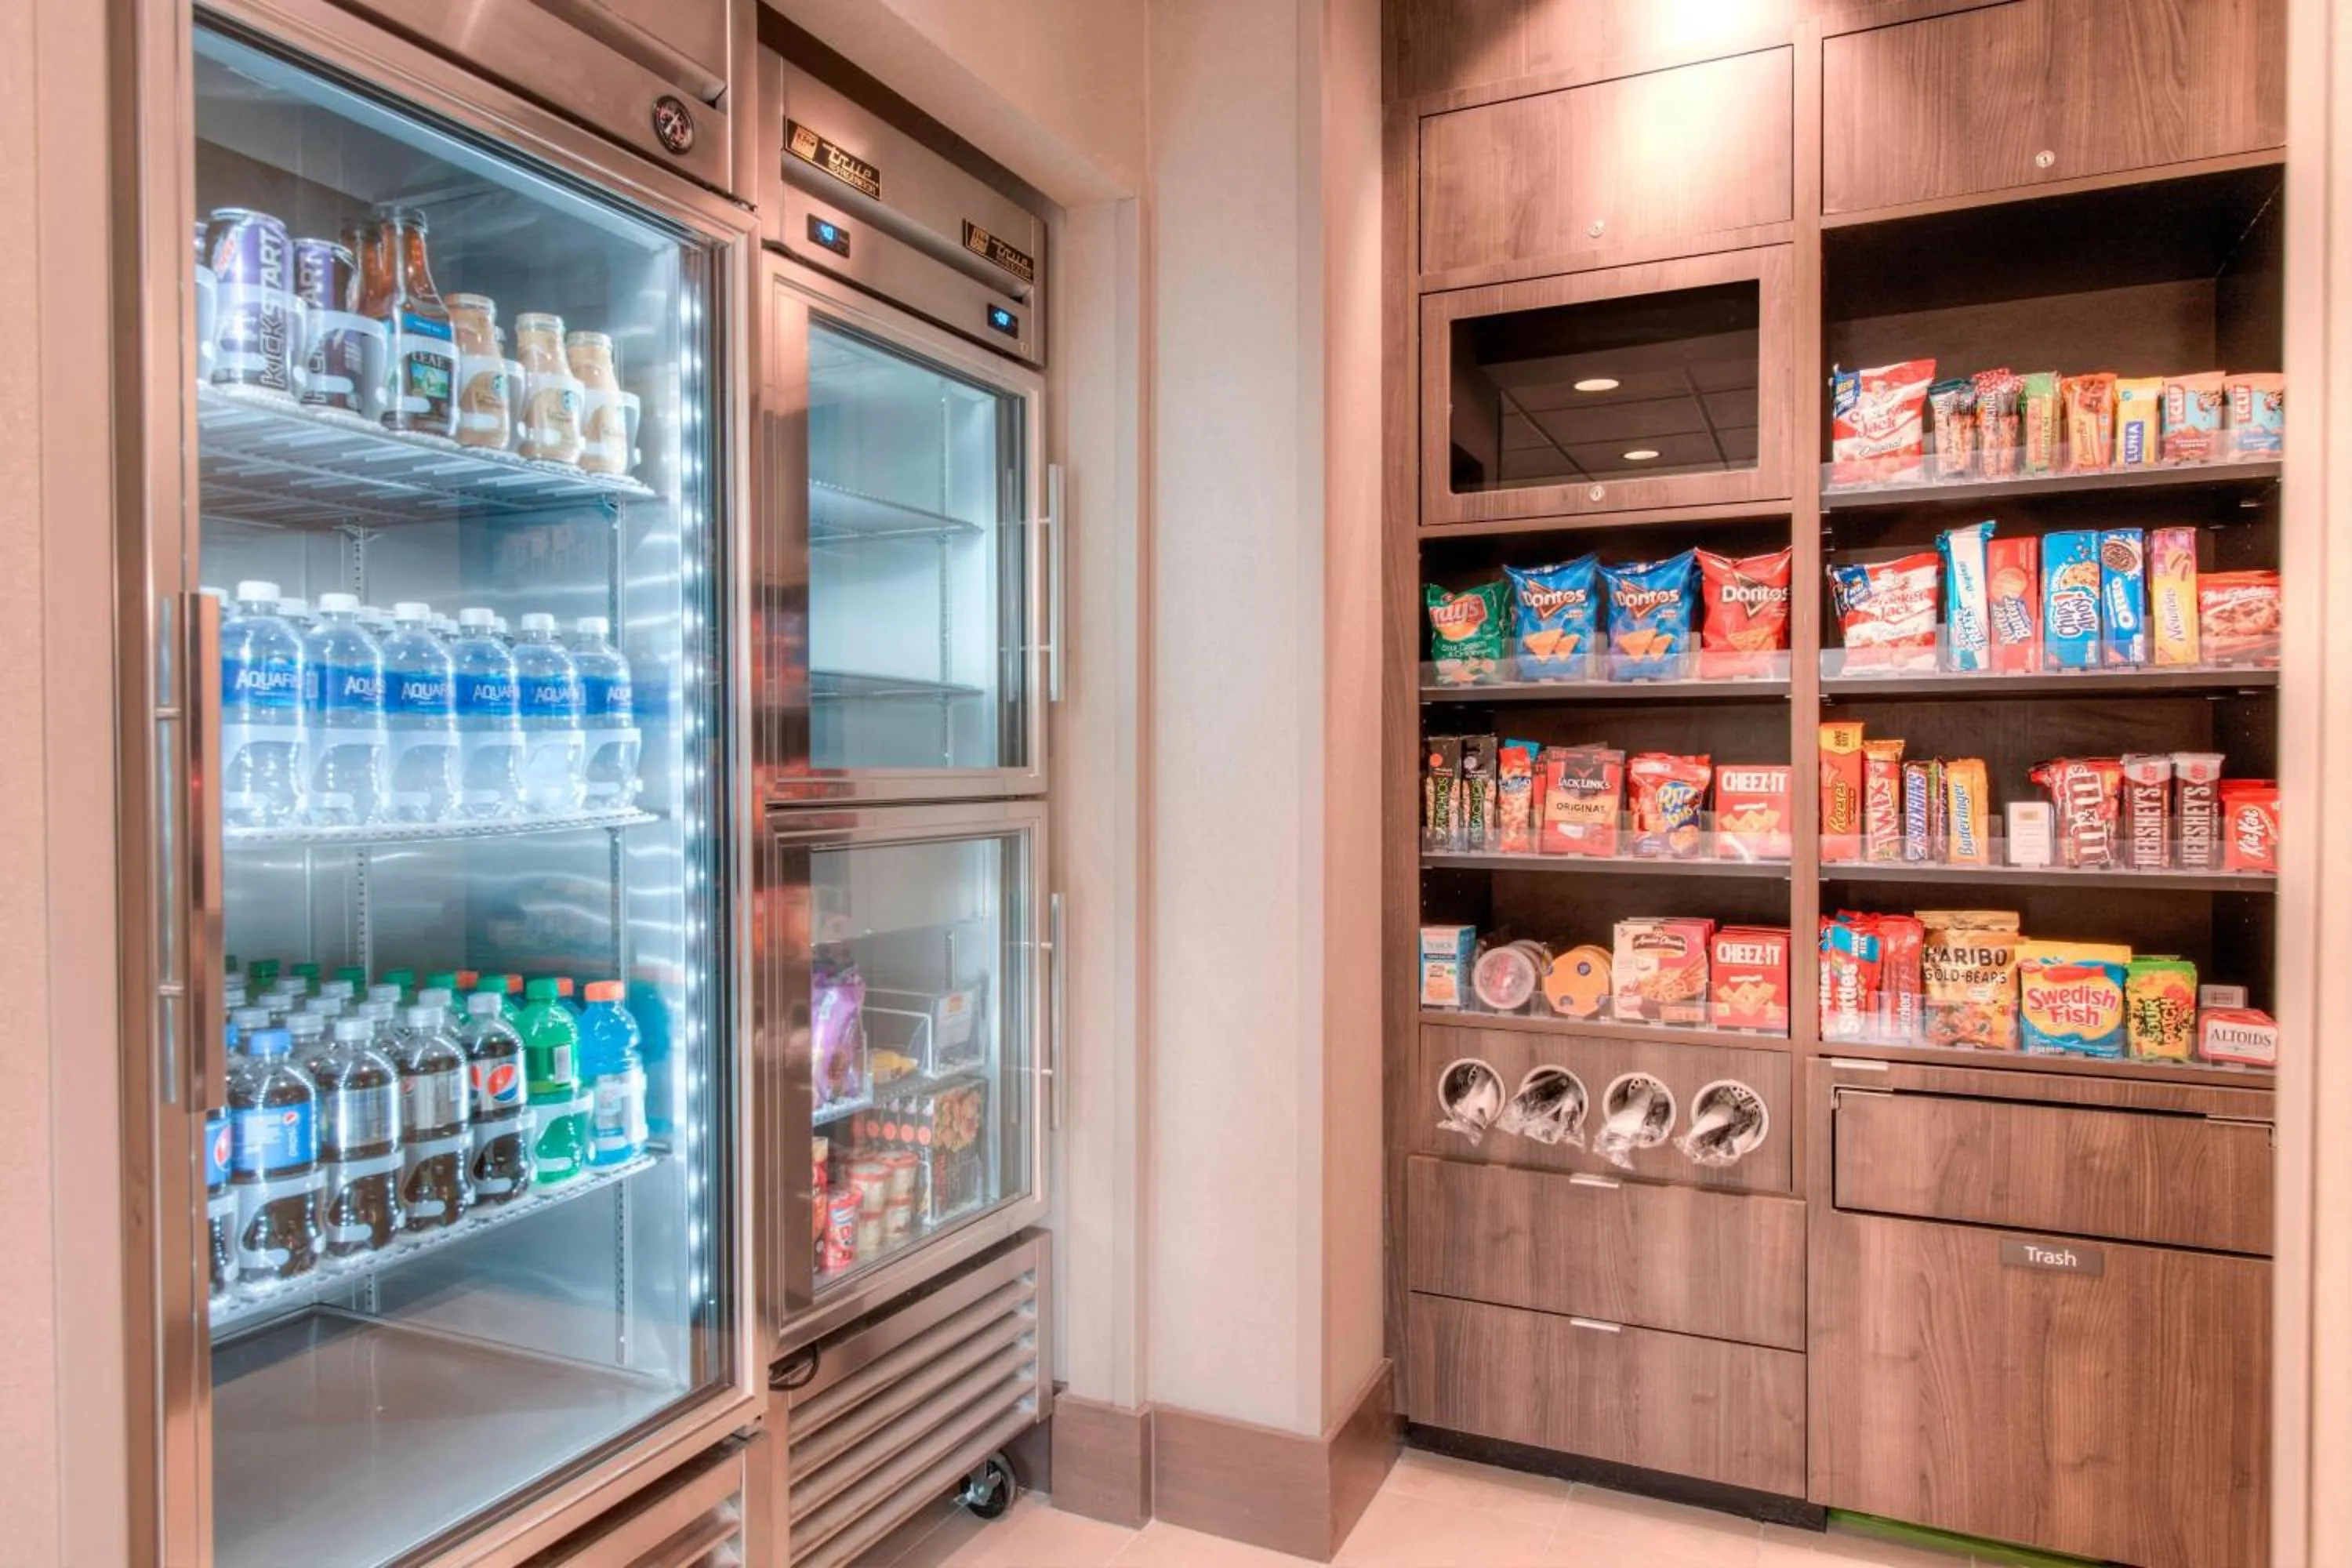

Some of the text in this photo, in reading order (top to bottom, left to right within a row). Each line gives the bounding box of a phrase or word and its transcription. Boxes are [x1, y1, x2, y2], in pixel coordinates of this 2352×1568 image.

[260, 227, 286, 390] KICKSTART
[2125, 423, 2141, 463] LUNA
[1522, 589, 1587, 607] Doritos
[1615, 589, 1680, 607] Doritos
[1722, 585, 1788, 603] Doritos
[2112, 577, 2135, 630] OREO
[1993, 603, 2018, 645] Nutter
[2004, 597, 2032, 641] Butter
[2057, 601, 2082, 637] Chips
[1865, 778, 1899, 854] TWIX
[1954, 782, 1975, 856] Butterfinger
[2133, 786, 2161, 866] HERSHEY'S
[2182, 786, 2211, 864] HERSHEY'S
[1924, 946, 2008, 967] HARIBO
[1924, 967, 2008, 984] GOLD-BEARS
[1837, 964, 1860, 1034] Skittles
[2027, 985, 2117, 1011] Swedish
[2047, 1004, 2100, 1026] Fish
[2145, 998, 2161, 1045] SOUR
[2160, 996, 2178, 1045] PATCH
[2210, 1028, 2272, 1048] ALTOIDS
[2023, 1245, 2078, 1268] Trash
